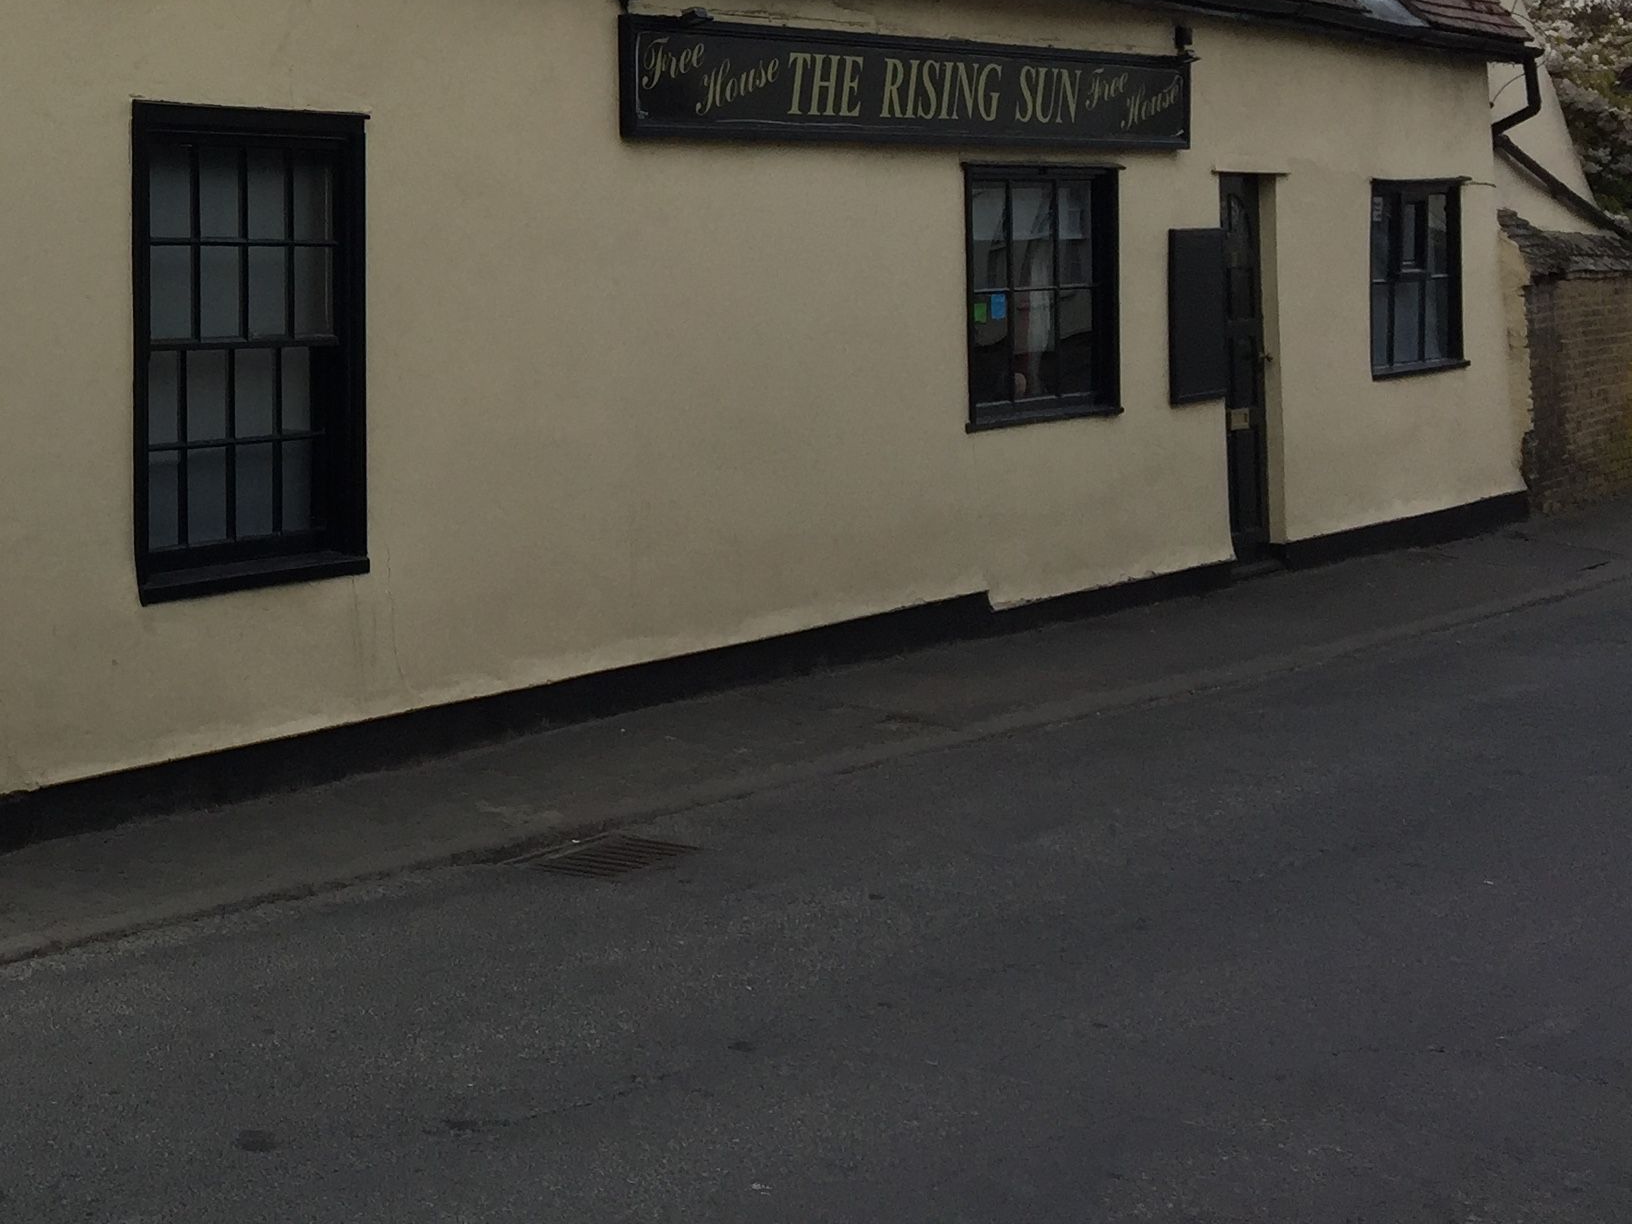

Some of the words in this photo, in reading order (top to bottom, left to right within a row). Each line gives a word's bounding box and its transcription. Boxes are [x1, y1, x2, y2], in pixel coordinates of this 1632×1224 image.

[642, 38, 705, 90] Free
[695, 56, 780, 116] House
[787, 53, 864, 117] THE
[879, 57, 1003, 123] RISING
[1015, 65, 1082, 124] SUN
[1085, 68, 1129, 112] Free
[1120, 73, 1180, 130] House
